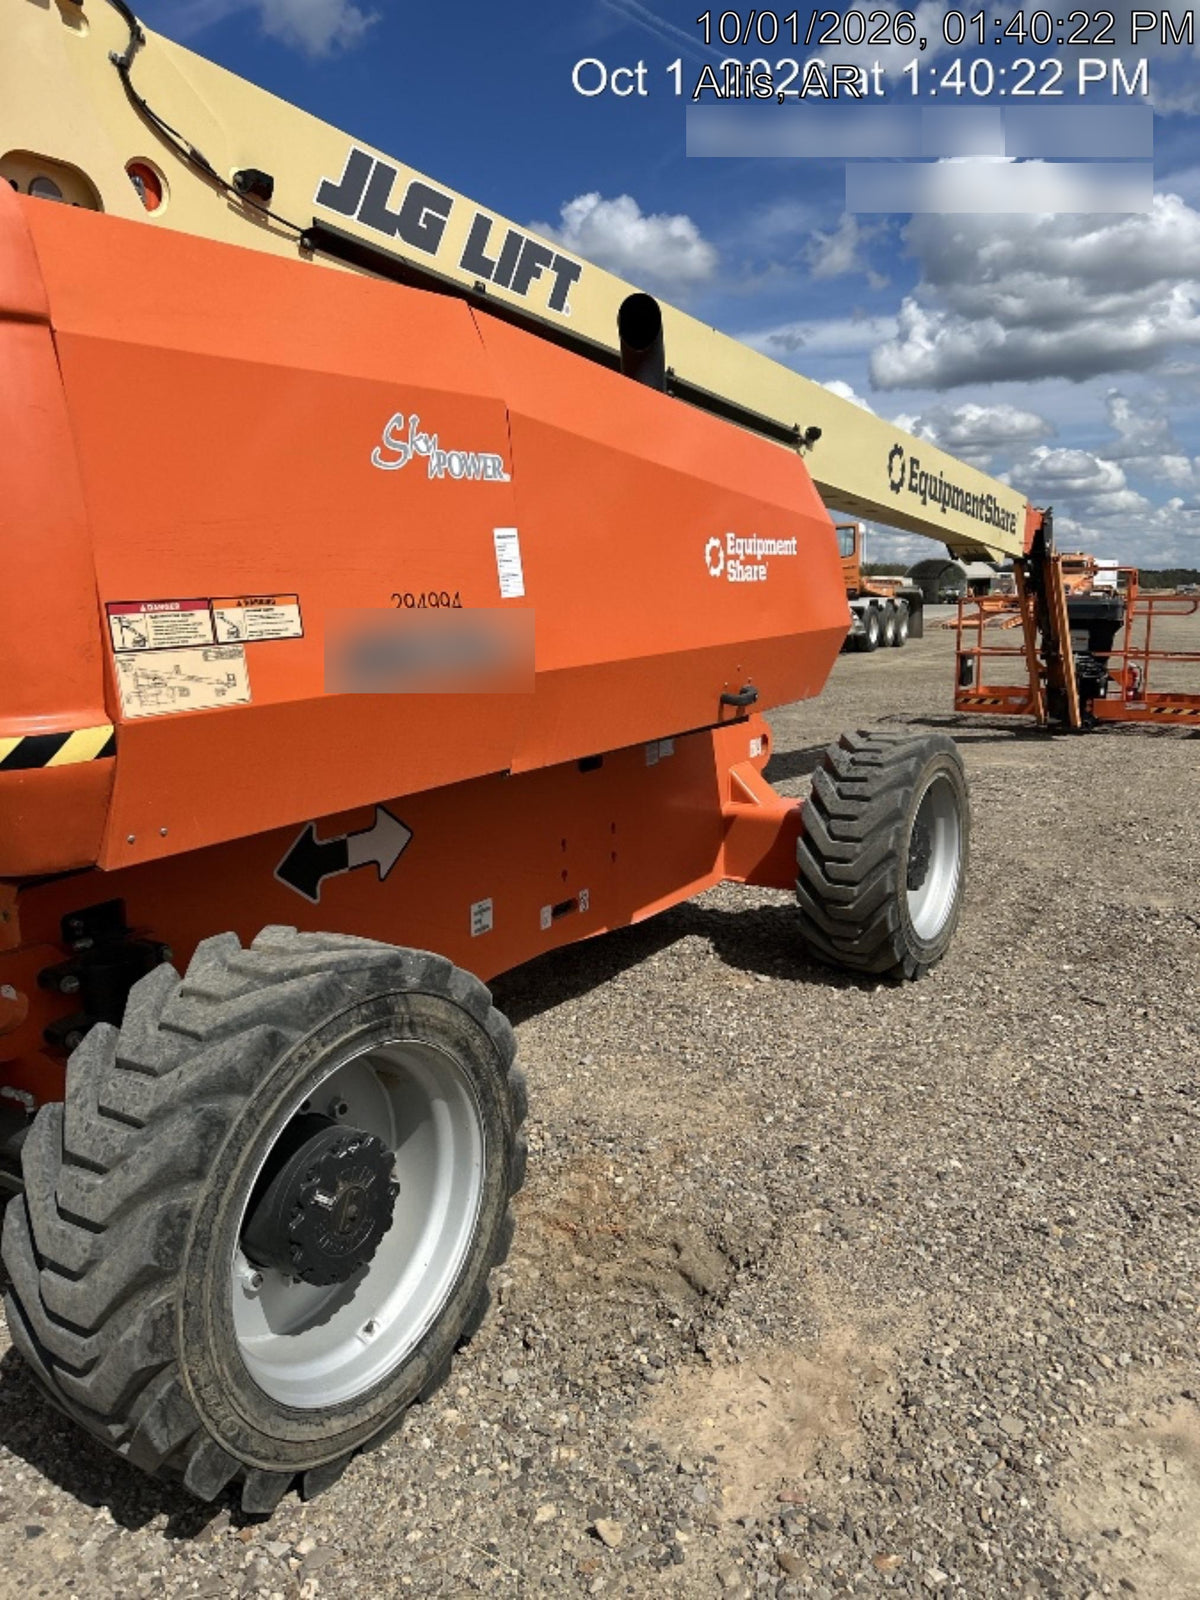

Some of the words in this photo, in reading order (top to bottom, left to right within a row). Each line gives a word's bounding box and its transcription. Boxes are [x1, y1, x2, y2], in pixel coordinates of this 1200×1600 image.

[314, 146, 454, 256] JLG
[459, 209, 583, 315] LIFT
[908, 456, 1018, 536] EquipmentShare
[726, 532, 797, 561] Equipment
[727, 559, 767, 582] Share
